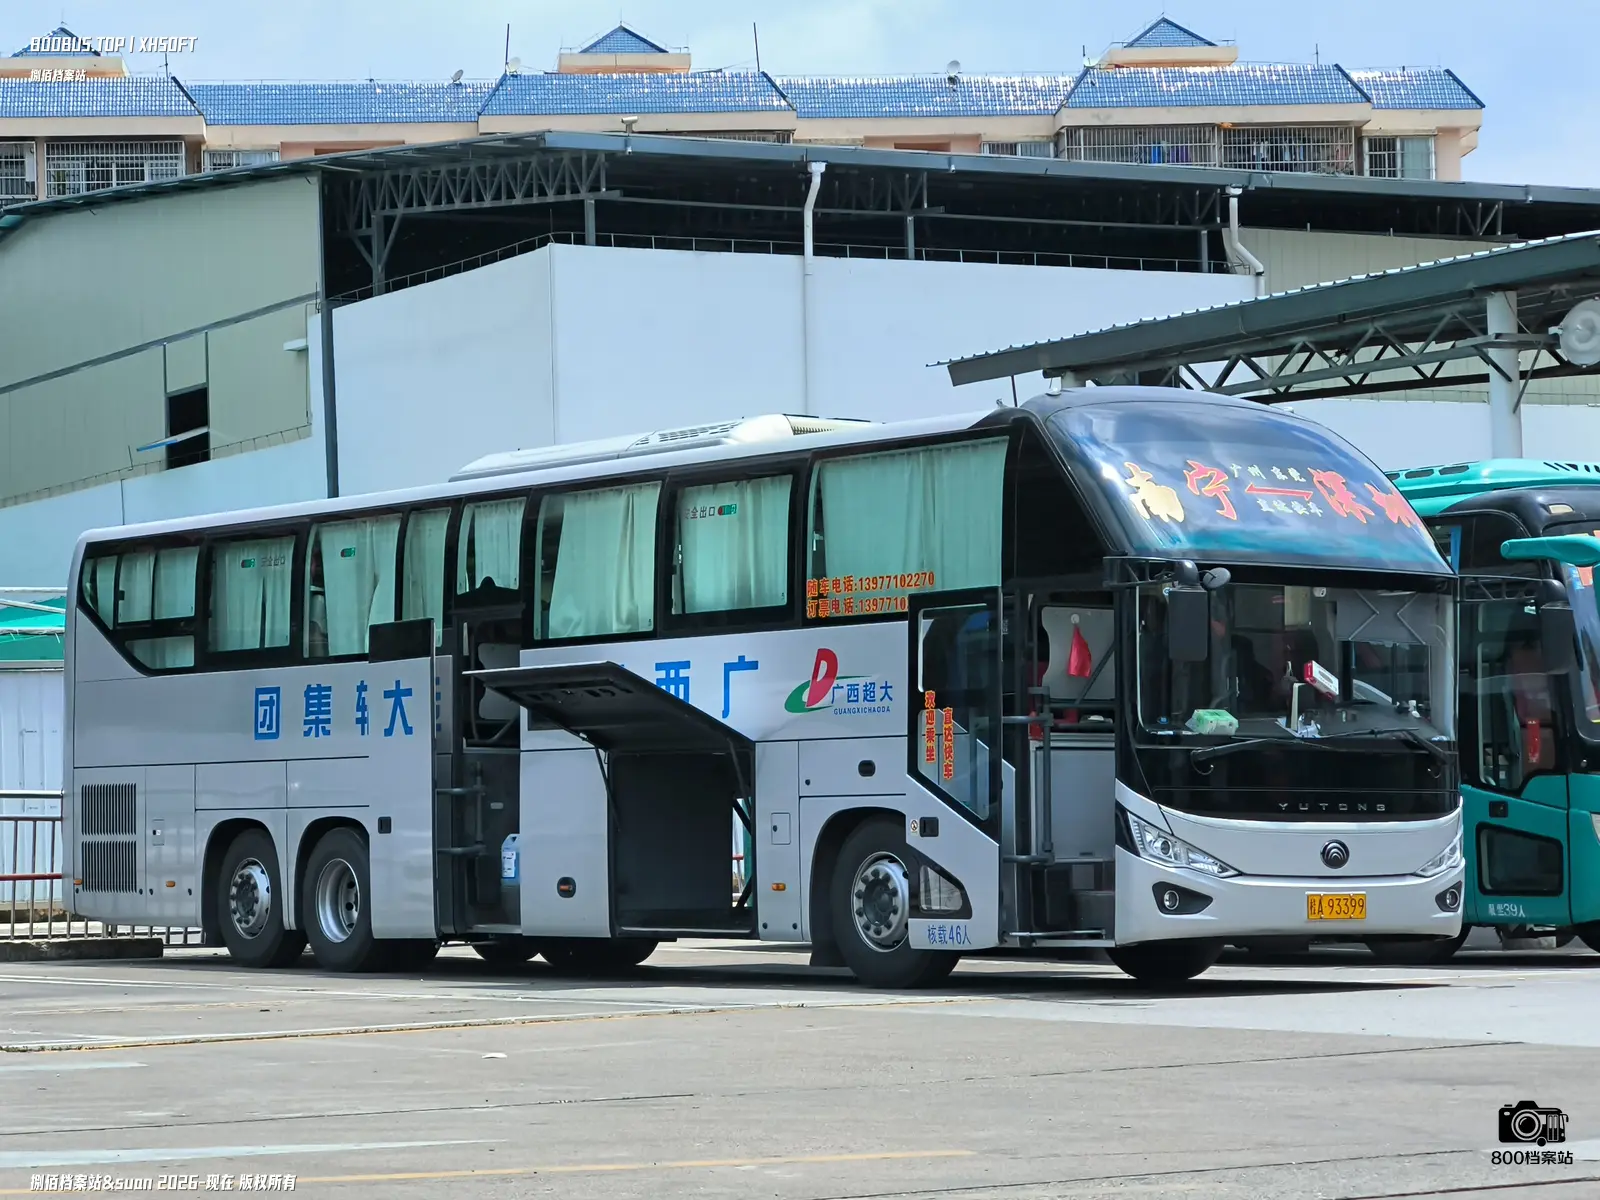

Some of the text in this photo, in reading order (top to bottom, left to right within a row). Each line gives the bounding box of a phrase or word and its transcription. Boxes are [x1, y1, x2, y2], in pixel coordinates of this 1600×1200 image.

[806, 596, 909, 619] 订票电话:1397710
[831, 680, 894, 704] 广西超大
[833, 705, 892, 716] GUANGXICHAODA
[924, 689, 936, 763] 欢迎乘坐
[1279, 802, 1386, 812] YUTONG
[927, 924, 972, 946] 核载46人
